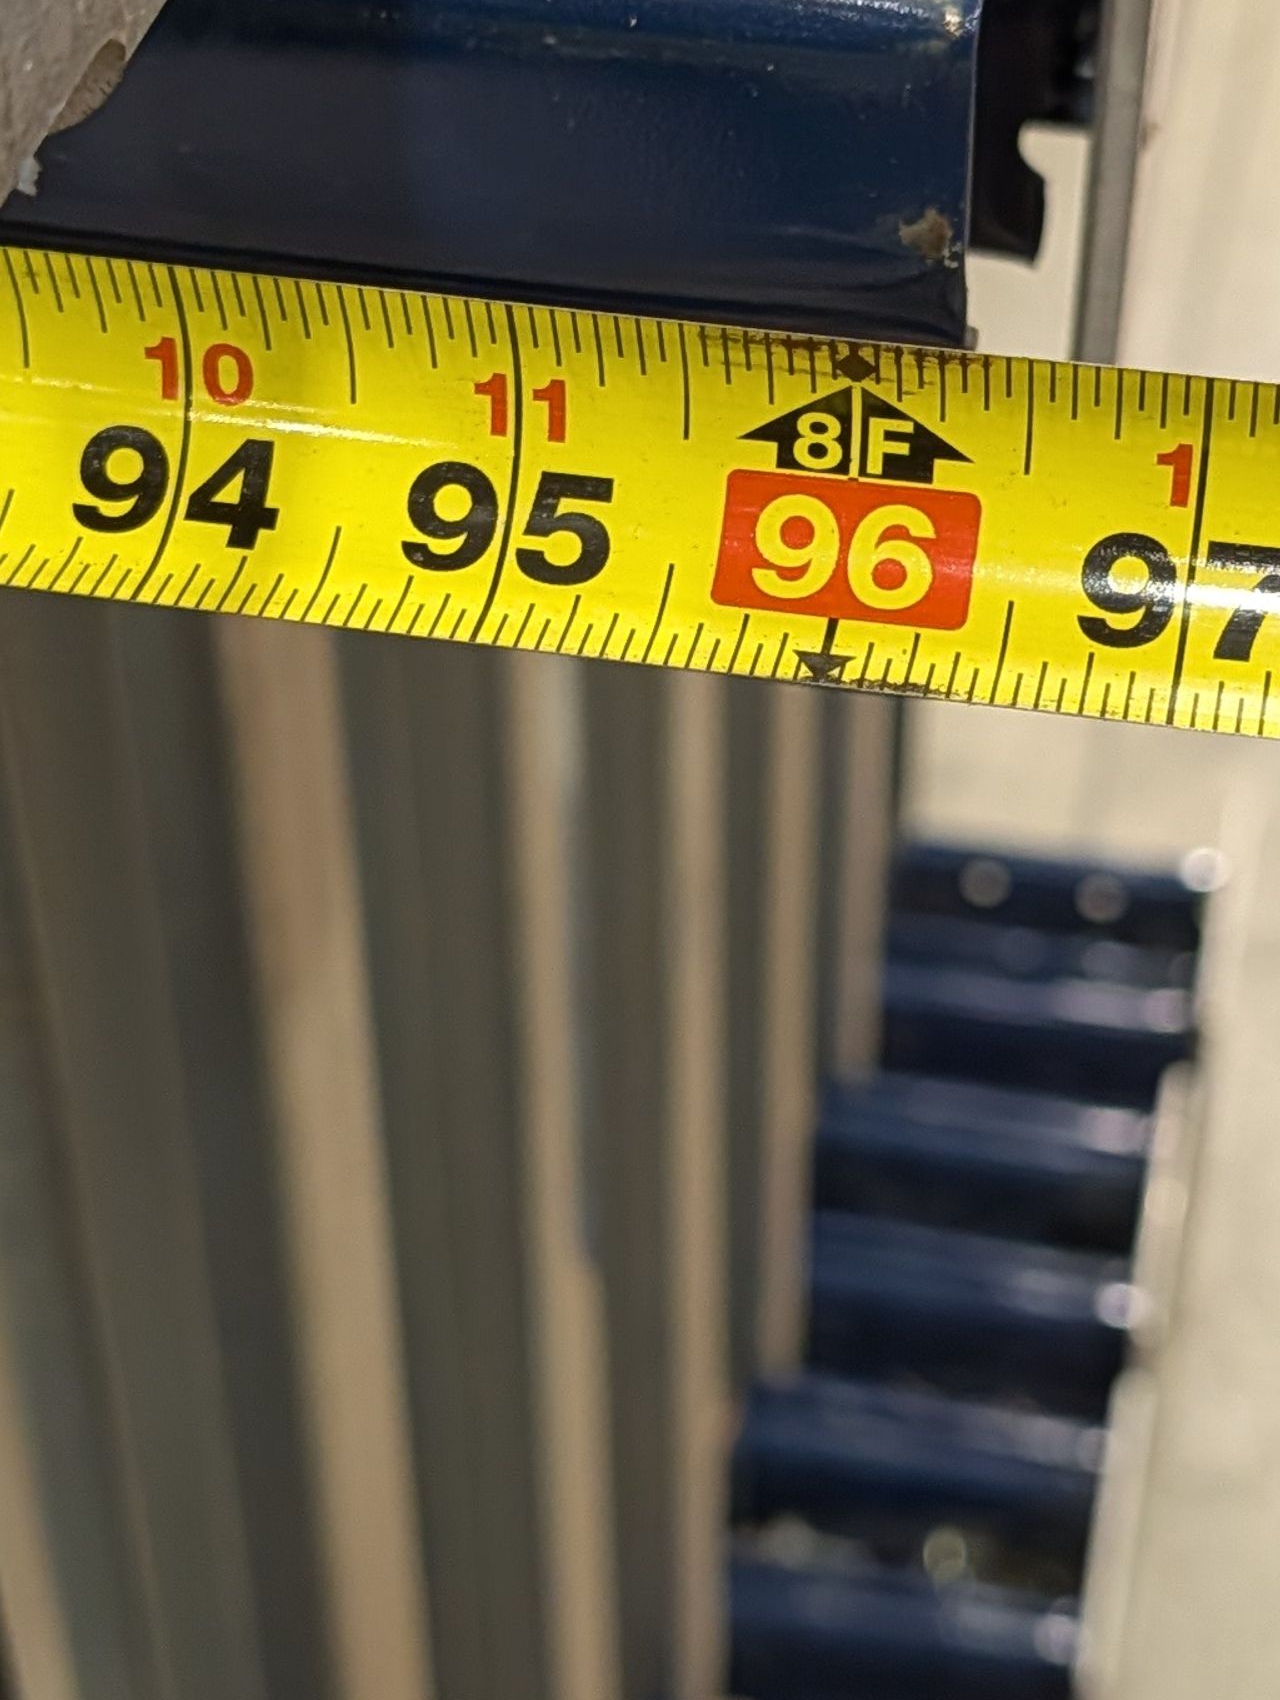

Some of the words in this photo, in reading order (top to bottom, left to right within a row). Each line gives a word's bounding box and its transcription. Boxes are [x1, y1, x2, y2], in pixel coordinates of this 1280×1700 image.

[144, 336, 253, 407] 10
[473, 373, 568, 443] 11
[72, 424, 280, 551] 94
[401, 460, 614, 587] 95
[750, 494, 937, 611] 96
[1156, 443, 1195, 508] 1
